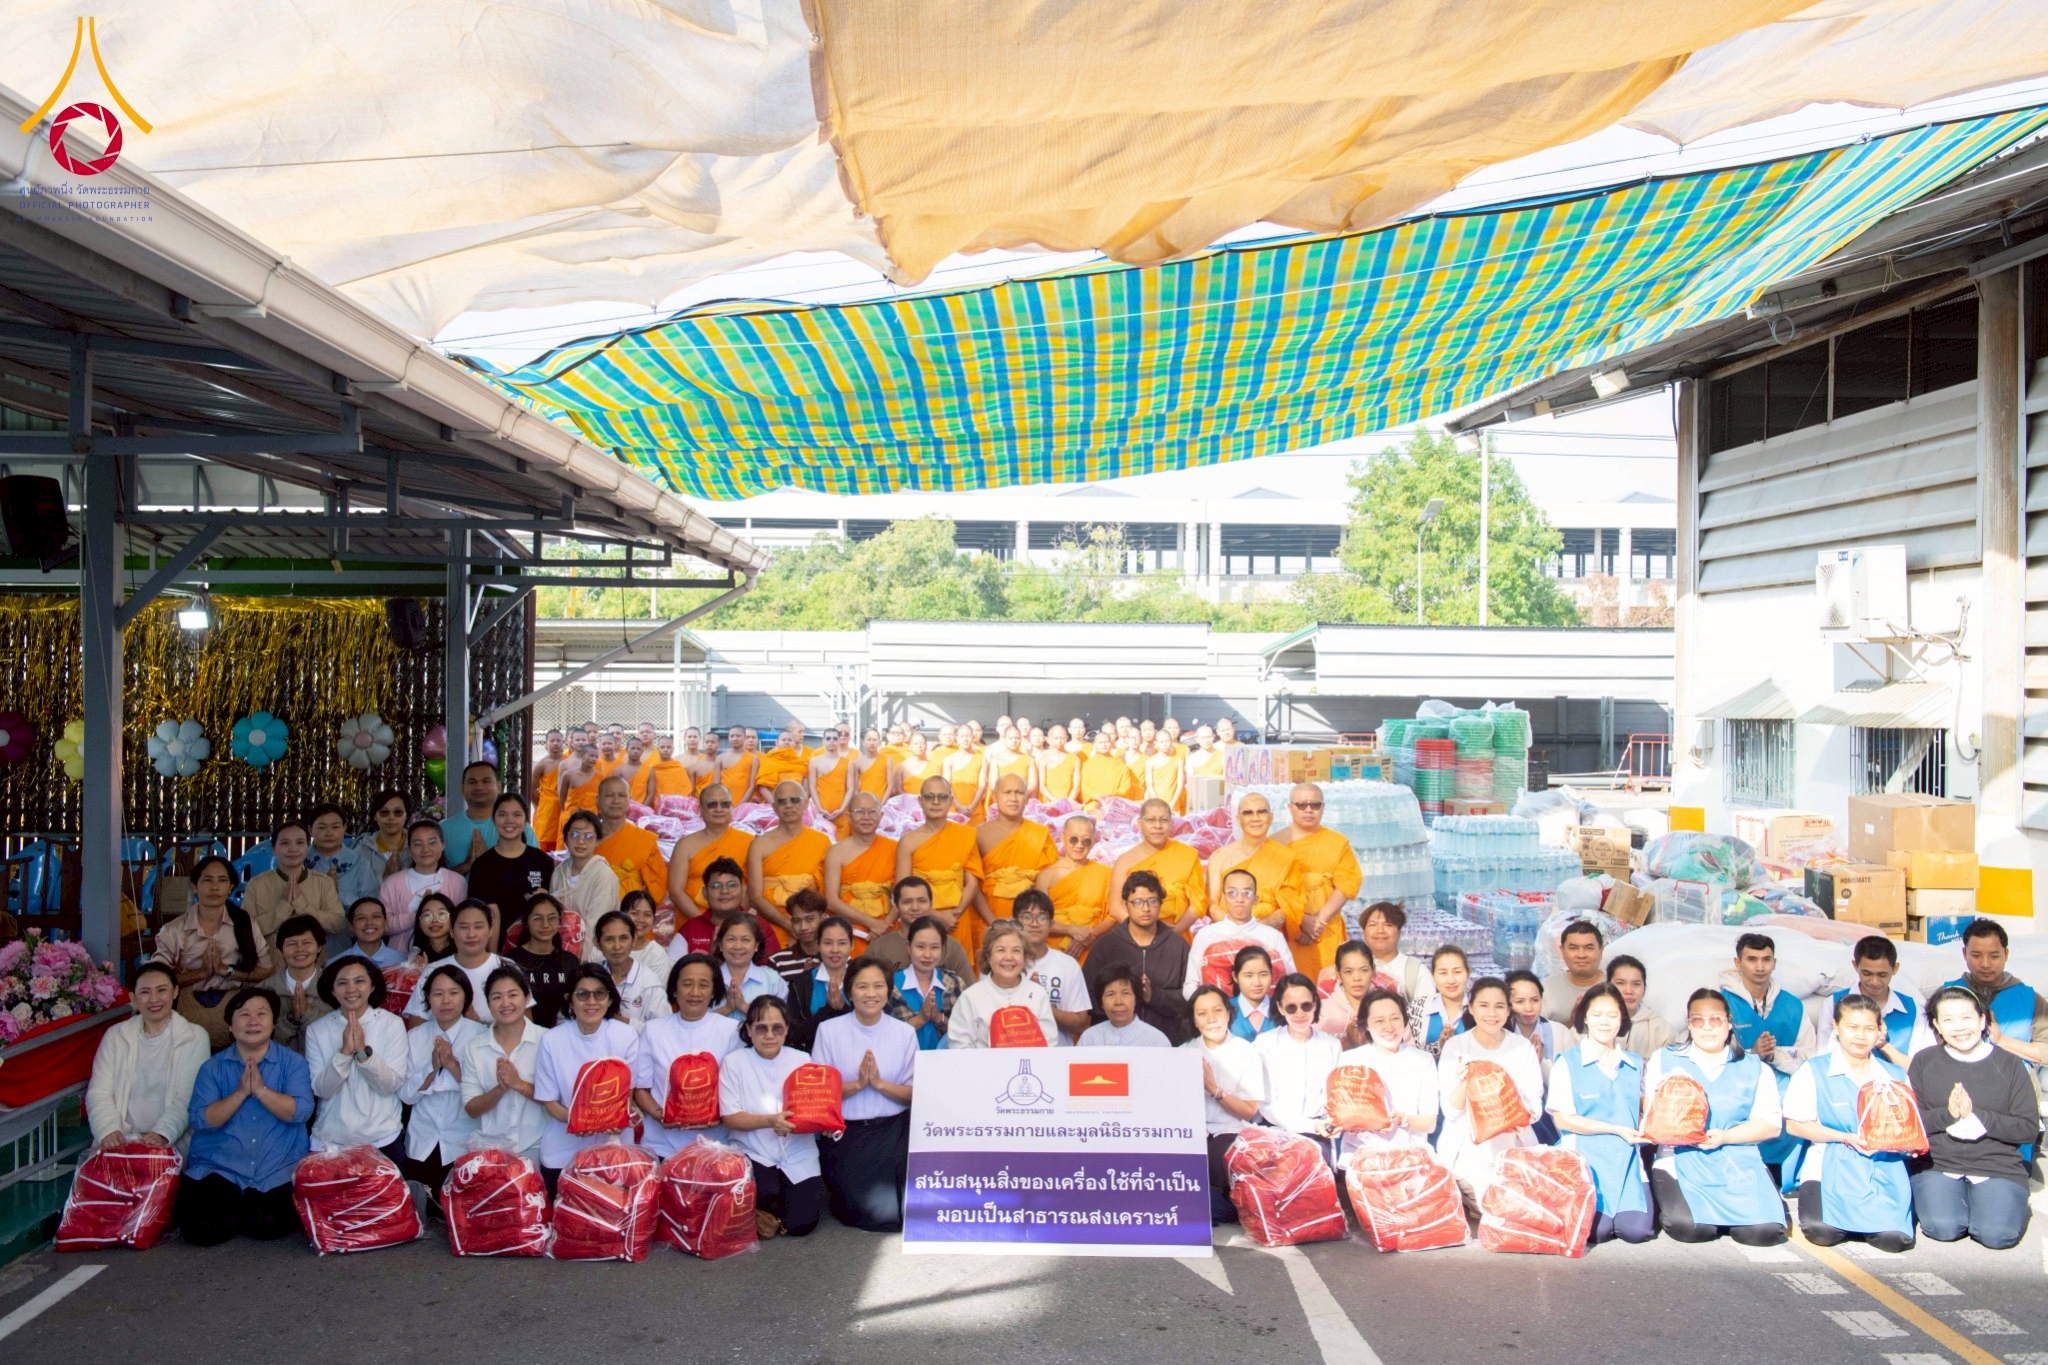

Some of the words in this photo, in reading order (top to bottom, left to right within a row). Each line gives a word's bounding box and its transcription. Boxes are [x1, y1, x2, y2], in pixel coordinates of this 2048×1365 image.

[995, 1106, 1055, 1115] วัดพระธรรมกาย
[923, 1121, 1193, 1143] วัดพระธรรมกายและมูลนิธิธรรมกาย
[915, 1165, 1201, 1195] สนับสนุนสิ่งของเครื่องใช้ที่จำเป็น
[936, 1201, 1179, 1226] มอบเป็นสาธารณสงเคราะห์
